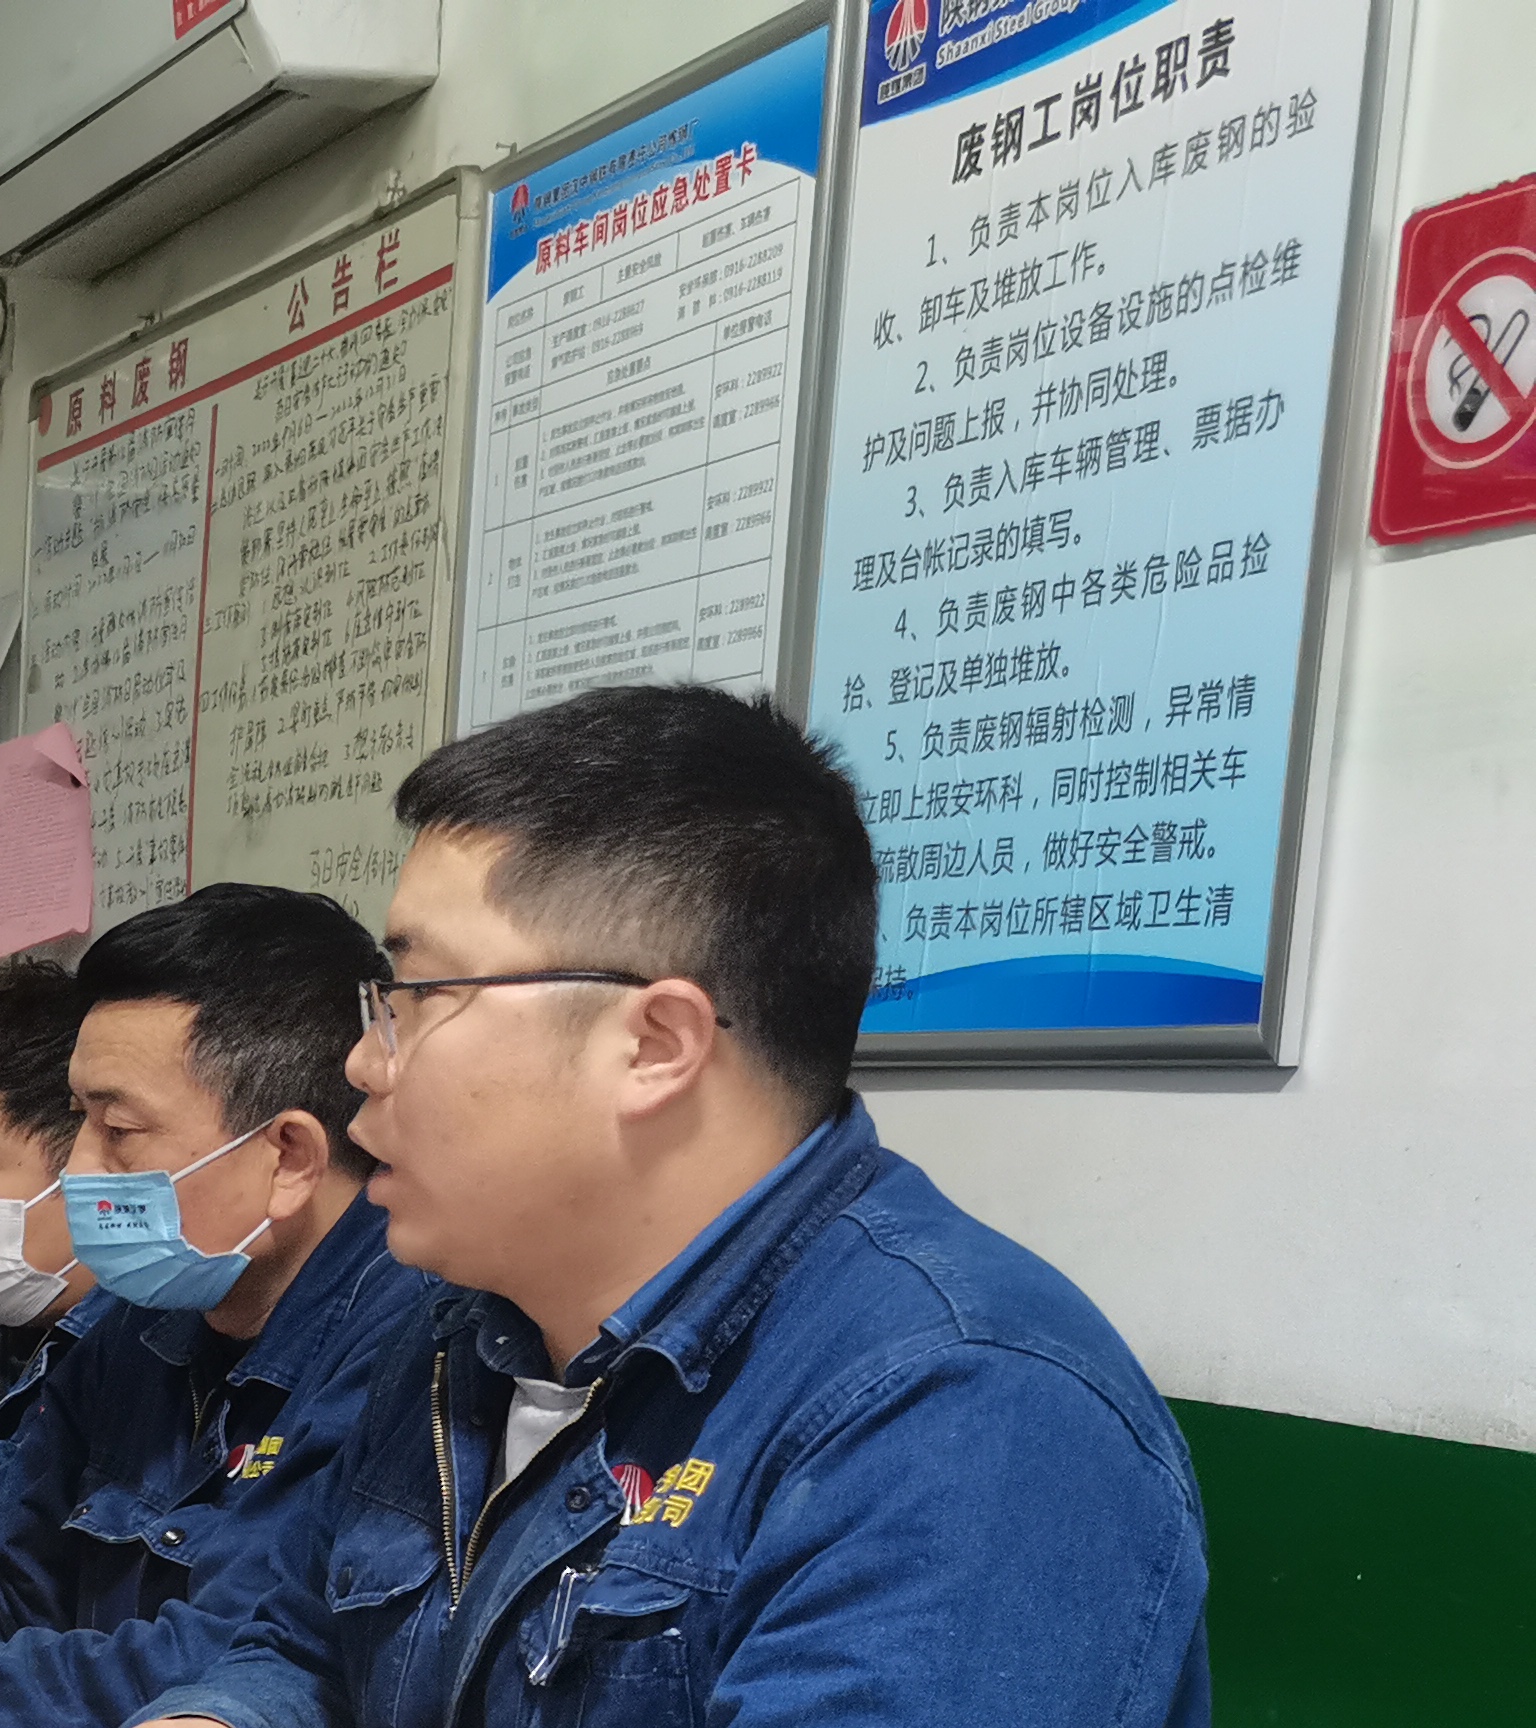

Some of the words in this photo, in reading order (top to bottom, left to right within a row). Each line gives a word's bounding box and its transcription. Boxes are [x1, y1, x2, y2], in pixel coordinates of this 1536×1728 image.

[938, 25, 992, 66] Shaanxi
[996, 5, 1031, 39] Steel
[950, 18, 1238, 184] 废钢工岗位职责
[534, 141, 758, 275] 原料车间岗位应急处置卡
[924, 87, 1318, 268] 1、负责本岗位入库废钢的验
[287, 228, 400, 334] 公告栏
[872, 240, 1107, 350] 收、卸车及堆放工作。
[915, 237, 1303, 394] 2、负责岗位设备设施的点检维
[66, 338, 189, 437] 原料废钢
[862, 349, 1179, 473] 护及问题上报，并协同处理。
[904, 388, 1286, 518] 3、负责入库车辆管理、票据办
[885, 674, 1257, 763] 5、负责废钢辐射检测，异常情
